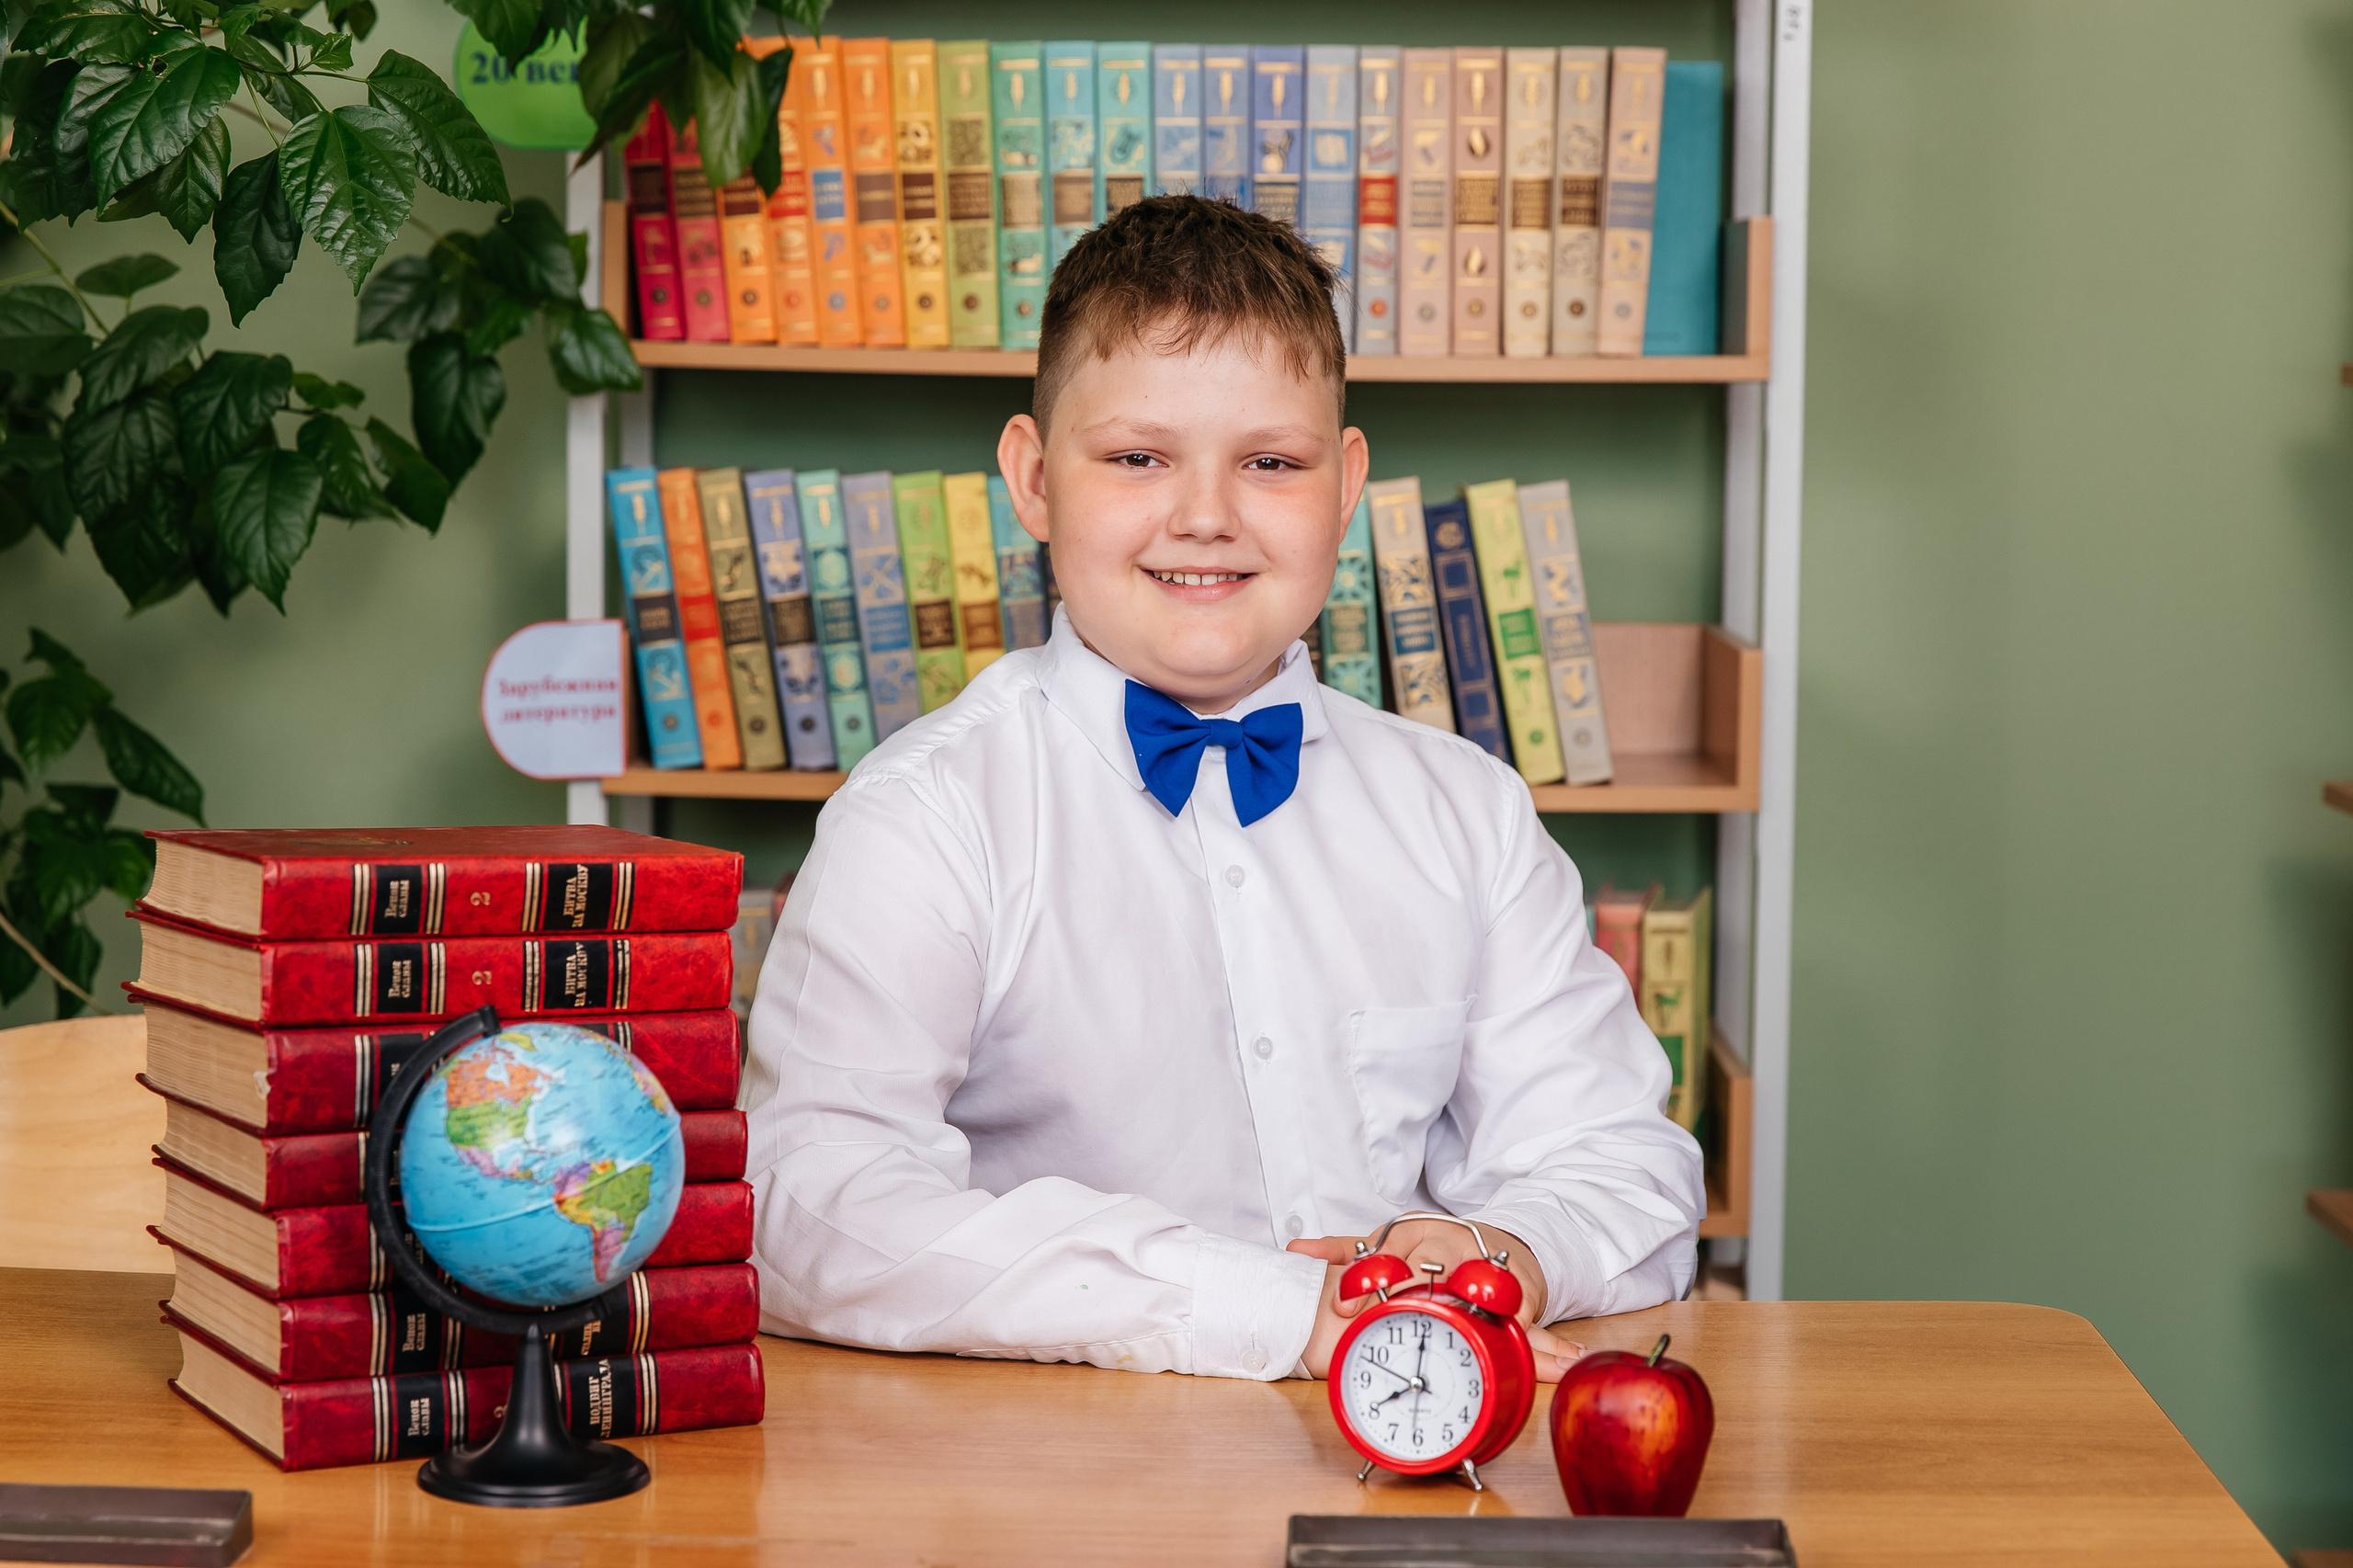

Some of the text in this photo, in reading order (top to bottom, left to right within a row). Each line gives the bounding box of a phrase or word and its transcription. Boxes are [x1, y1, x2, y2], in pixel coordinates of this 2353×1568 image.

[384, 880, 399, 918] Венок
[399, 880, 410, 917] славы
[470, 892, 491, 906] 2
[563, 876, 576, 916] БИТВА
[572, 864, 589, 927] ЗА МОСКВУ
[388, 960, 402, 998] Венок
[402, 960, 412, 998] славы
[472, 971, 493, 985] 2
[564, 954, 576, 995] БИТВА
[574, 941, 587, 1006] ЗА МОСКВУ
[402, 1313, 415, 1352] Венок
[415, 1312, 426, 1351] славы
[1388, 1326, 1404, 1345] 11
[1411, 1320, 1432, 1338] 12
[1447, 1331, 1454, 1349] 1
[1369, 1346, 1389, 1365] 10
[1460, 1349, 1472, 1367] 2
[1360, 1371, 1371, 1390] 9
[1469, 1380, 1480, 1399] 3
[588, 1376, 602, 1425] ПОДВИГ
[407, 1399, 420, 1437] Венок
[420, 1397, 430, 1436] славы
[1369, 1402, 1380, 1420] 8
[1458, 1406, 1471, 1424] 4
[1388, 1423, 1400, 1442] 7
[1413, 1428, 1424, 1447] 6
[1442, 1424, 1453, 1442] 5
